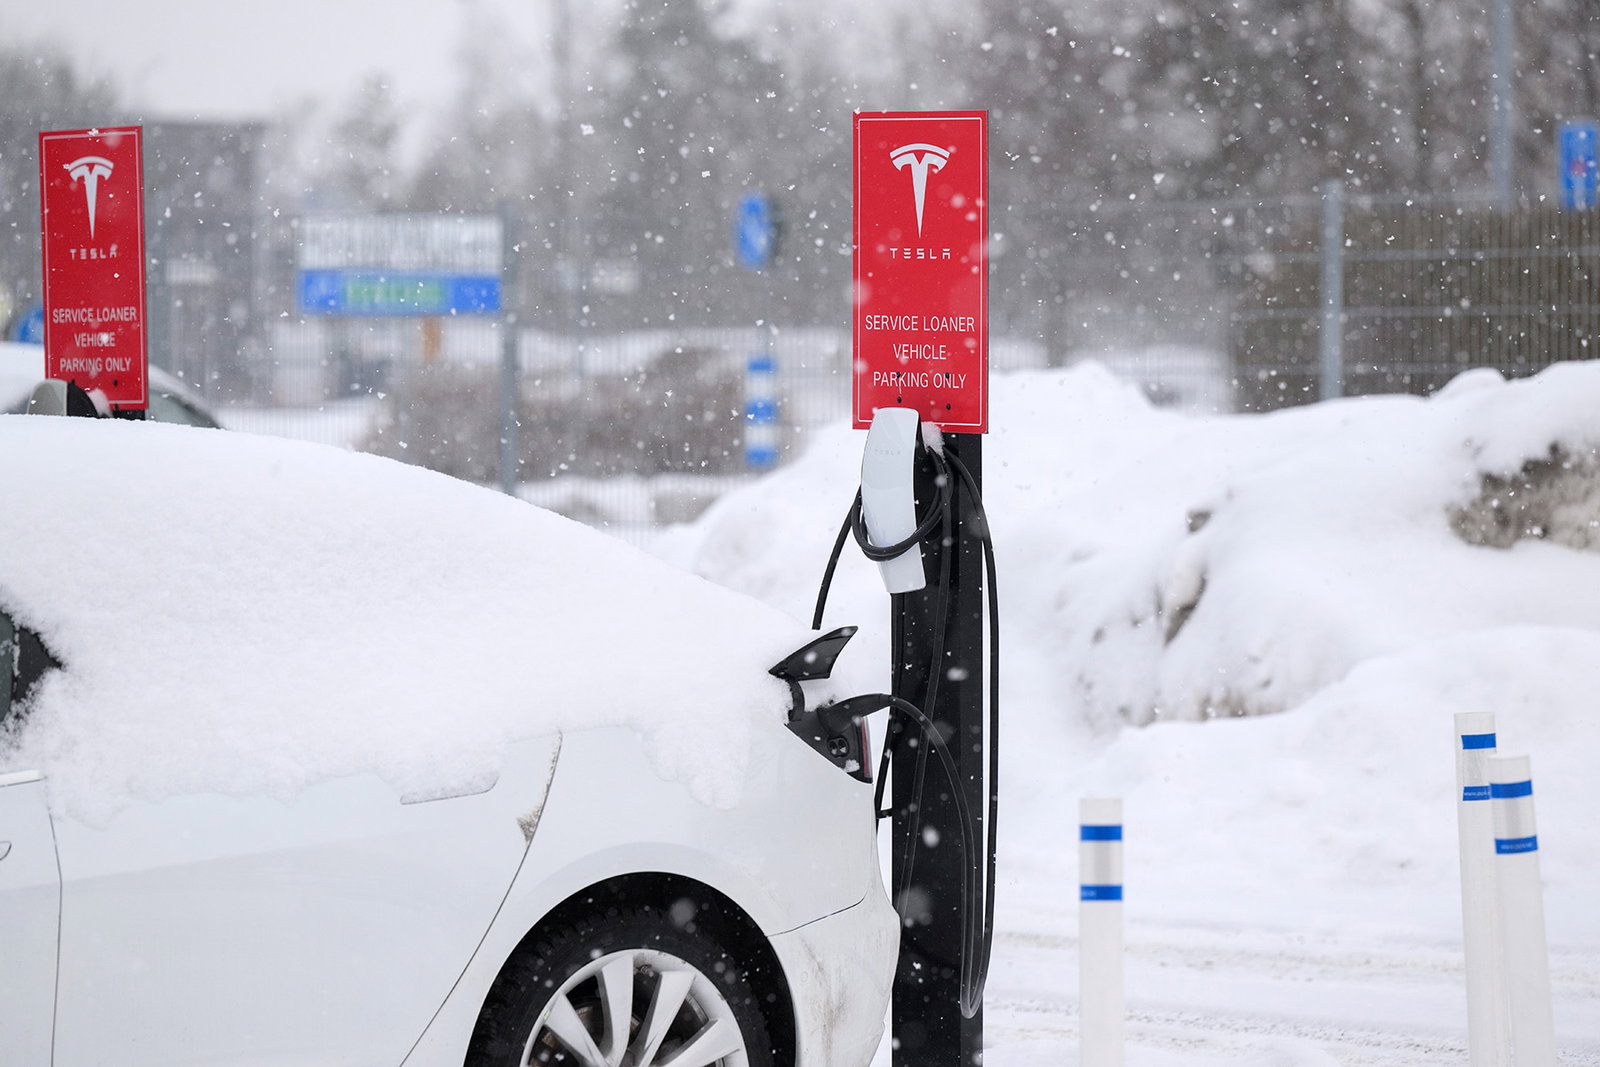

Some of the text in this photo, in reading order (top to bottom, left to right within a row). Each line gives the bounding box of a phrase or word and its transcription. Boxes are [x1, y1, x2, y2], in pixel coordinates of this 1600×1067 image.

[69, 247, 117, 260] TESLA
[890, 248, 951, 260] TESLA
[53, 306, 137, 323] SERVICE LOANER
[865, 315, 975, 332] SERVICE LOANER
[893, 344, 947, 360] VEHICLE
[59, 357, 131, 372] PARKING ONLY
[873, 371, 967, 389] PARKING ONLY
